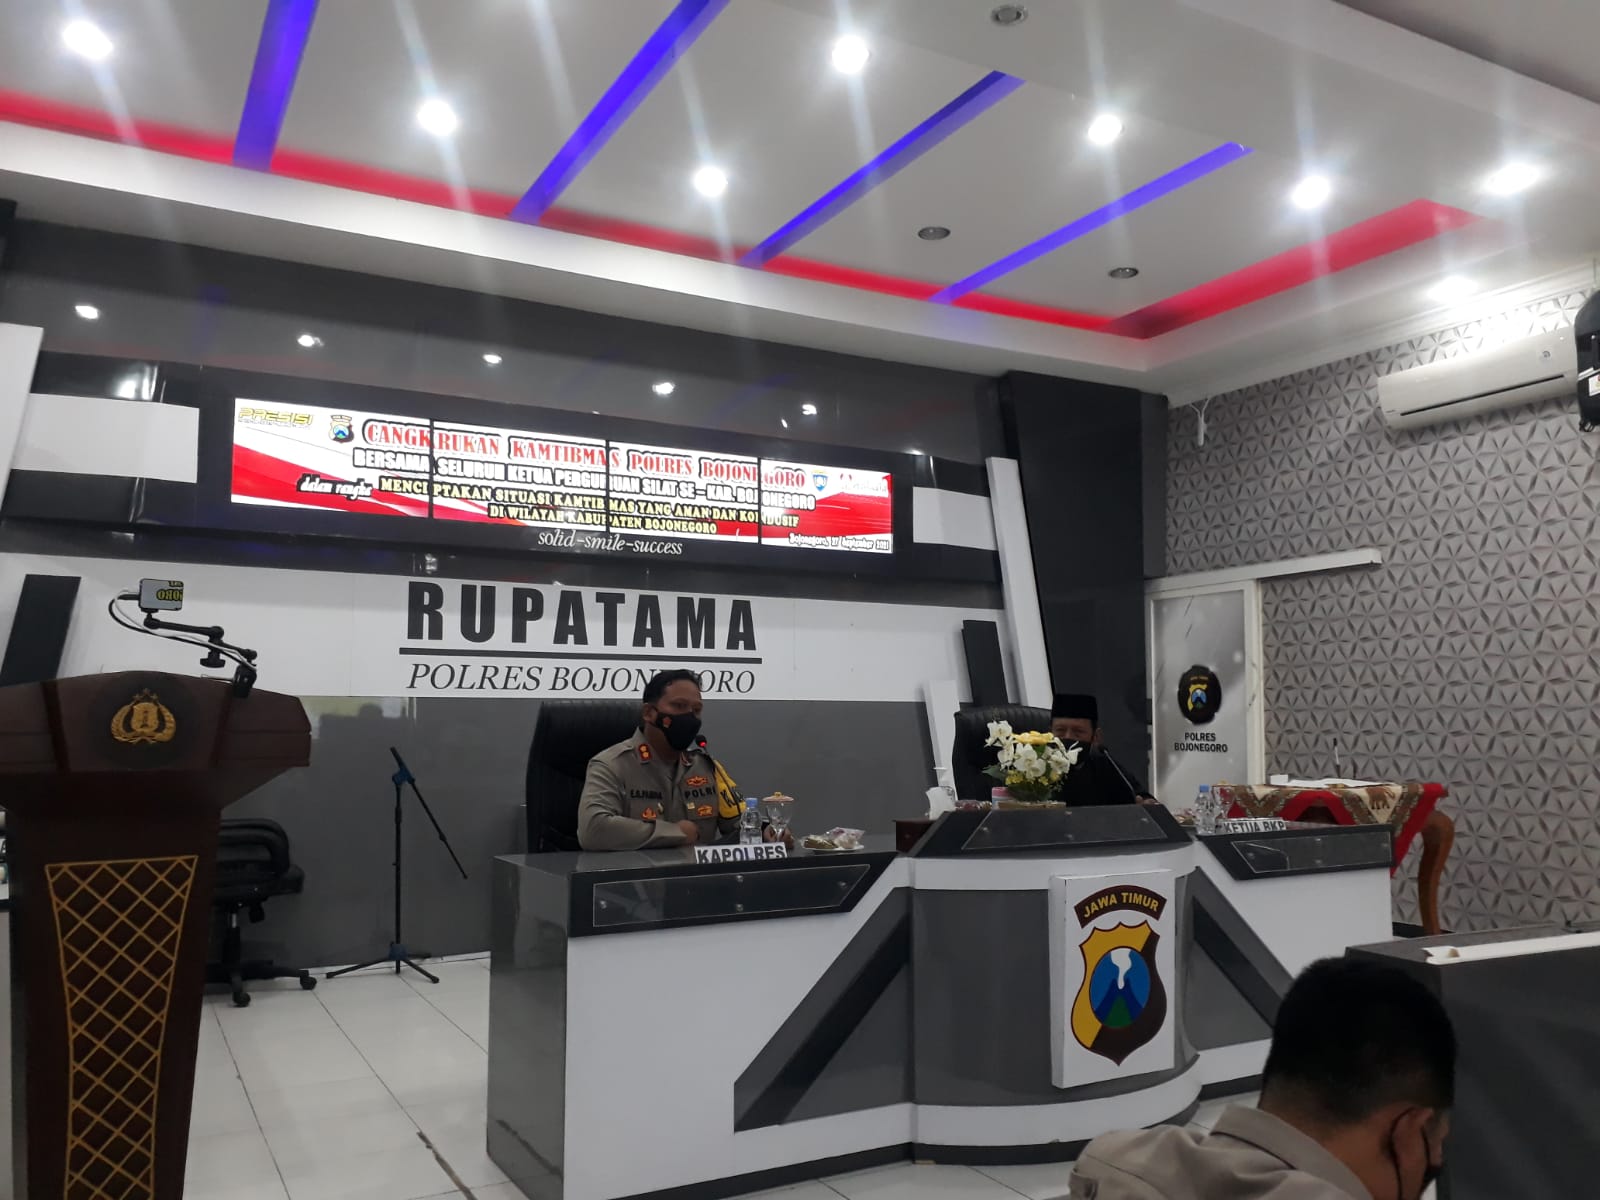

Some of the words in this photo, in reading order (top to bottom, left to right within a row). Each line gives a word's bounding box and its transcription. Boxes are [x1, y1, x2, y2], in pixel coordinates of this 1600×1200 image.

[238, 408, 313, 426] PRESISI
[367, 422, 500, 456] CANGKRUKAN
[512, 440, 620, 468] KAMTIBMAS
[630, 453, 693, 476] POLRES
[703, 461, 806, 489] BOJONEGORO
[354, 447, 437, 474] BERSAMA
[438, 457, 506, 480] SELURUH
[507, 464, 554, 486] KETUA
[555, 469, 641, 494] PERGURUAN
[642, 477, 677, 498] SILAT
[736, 486, 816, 511] BOJONEGORO
[380, 478, 492, 500] MENCIPTAKAN
[495, 487, 551, 505] SITUASI
[553, 492, 635, 514] KAMTIBMAS
[637, 501, 672, 517] YANG
[674, 505, 710, 520] AMAN
[711, 507, 738, 522] DAN
[738, 510, 800, 529] KONDUSIF
[489, 503, 505, 518] DI
[506, 505, 564, 522] WILAYAH
[565, 509, 642, 530] KABUPATEN
[643, 516, 718, 535] BOJONEGORO
[406, 580, 757, 651] RUPATAMA
[406, 663, 541, 691] POLRES
[548, 667, 755, 694] BOJONORO
[1174, 742, 1229, 753] BOJONEGORO
[1184, 732, 1217, 742] POLRES
[697, 845, 786, 863] KAPOLRES
[1083, 895, 1118, 919] JAWA
[1120, 892, 1160, 913] TIMUR
